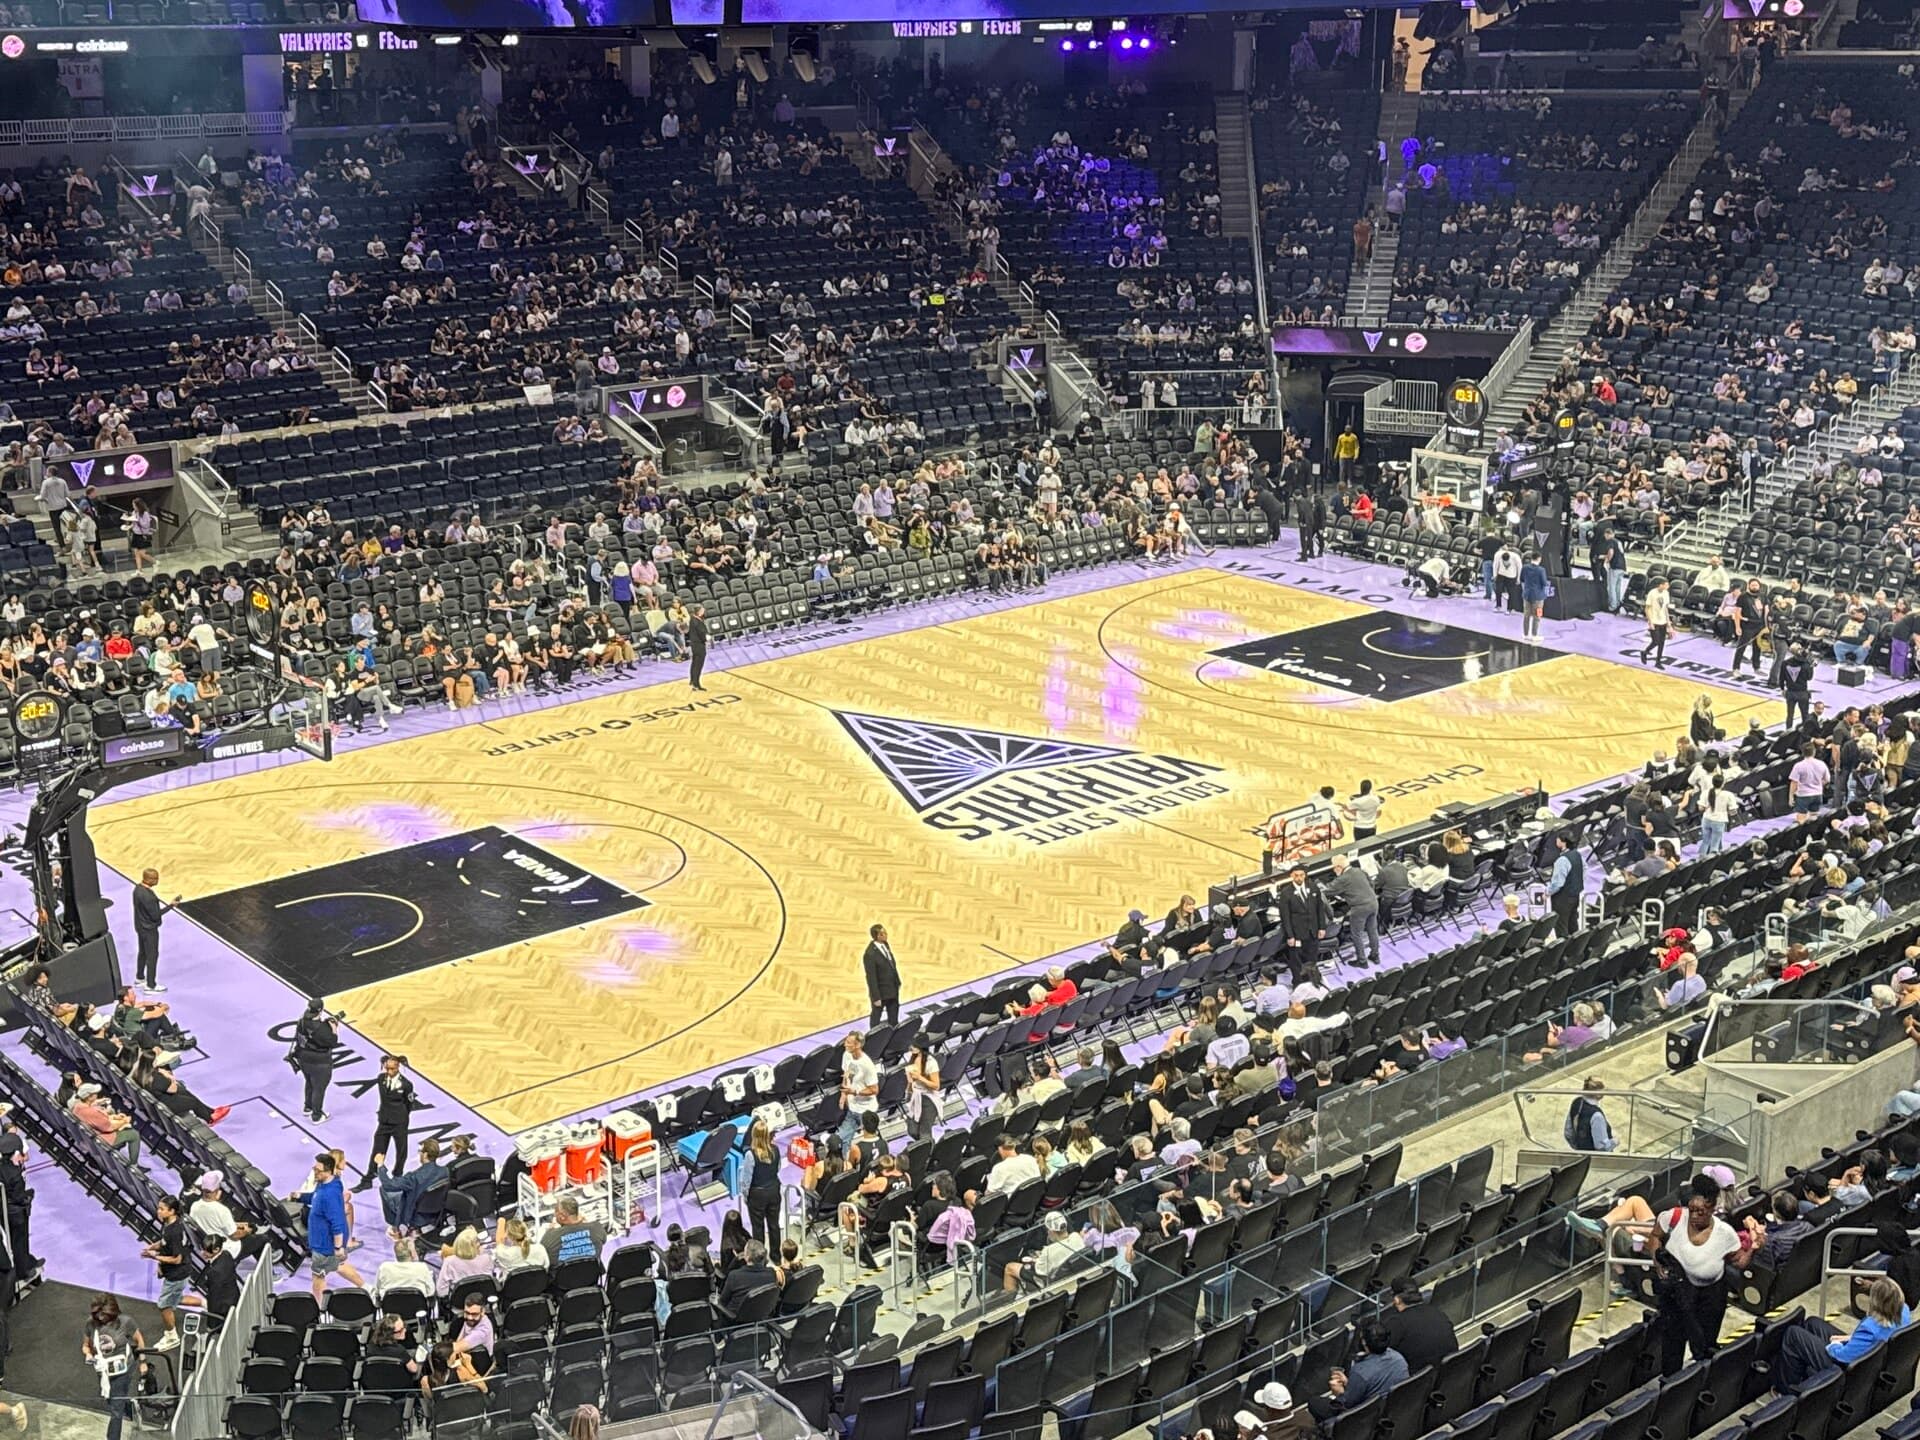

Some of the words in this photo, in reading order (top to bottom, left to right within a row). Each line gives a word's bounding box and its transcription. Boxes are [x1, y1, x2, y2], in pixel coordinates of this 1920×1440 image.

[279, 32, 352, 51] VALKYRIES
[892, 21, 957, 37] VALKYRIES
[983, 20, 1021, 35] FEVER
[1223, 562, 1394, 602] WAYMO
[631, 694, 742, 723] CHASE
[119, 739, 165, 754] coinbase
[481, 727, 597, 756] CENTER
[1377, 764, 1485, 797] CHASE
[922, 754, 1226, 841] VALKYRIES
[1109, 781, 1230, 818] GOLDEN
[1013, 812, 1118, 845] STATE
[502, 849, 569, 885] WNBA
